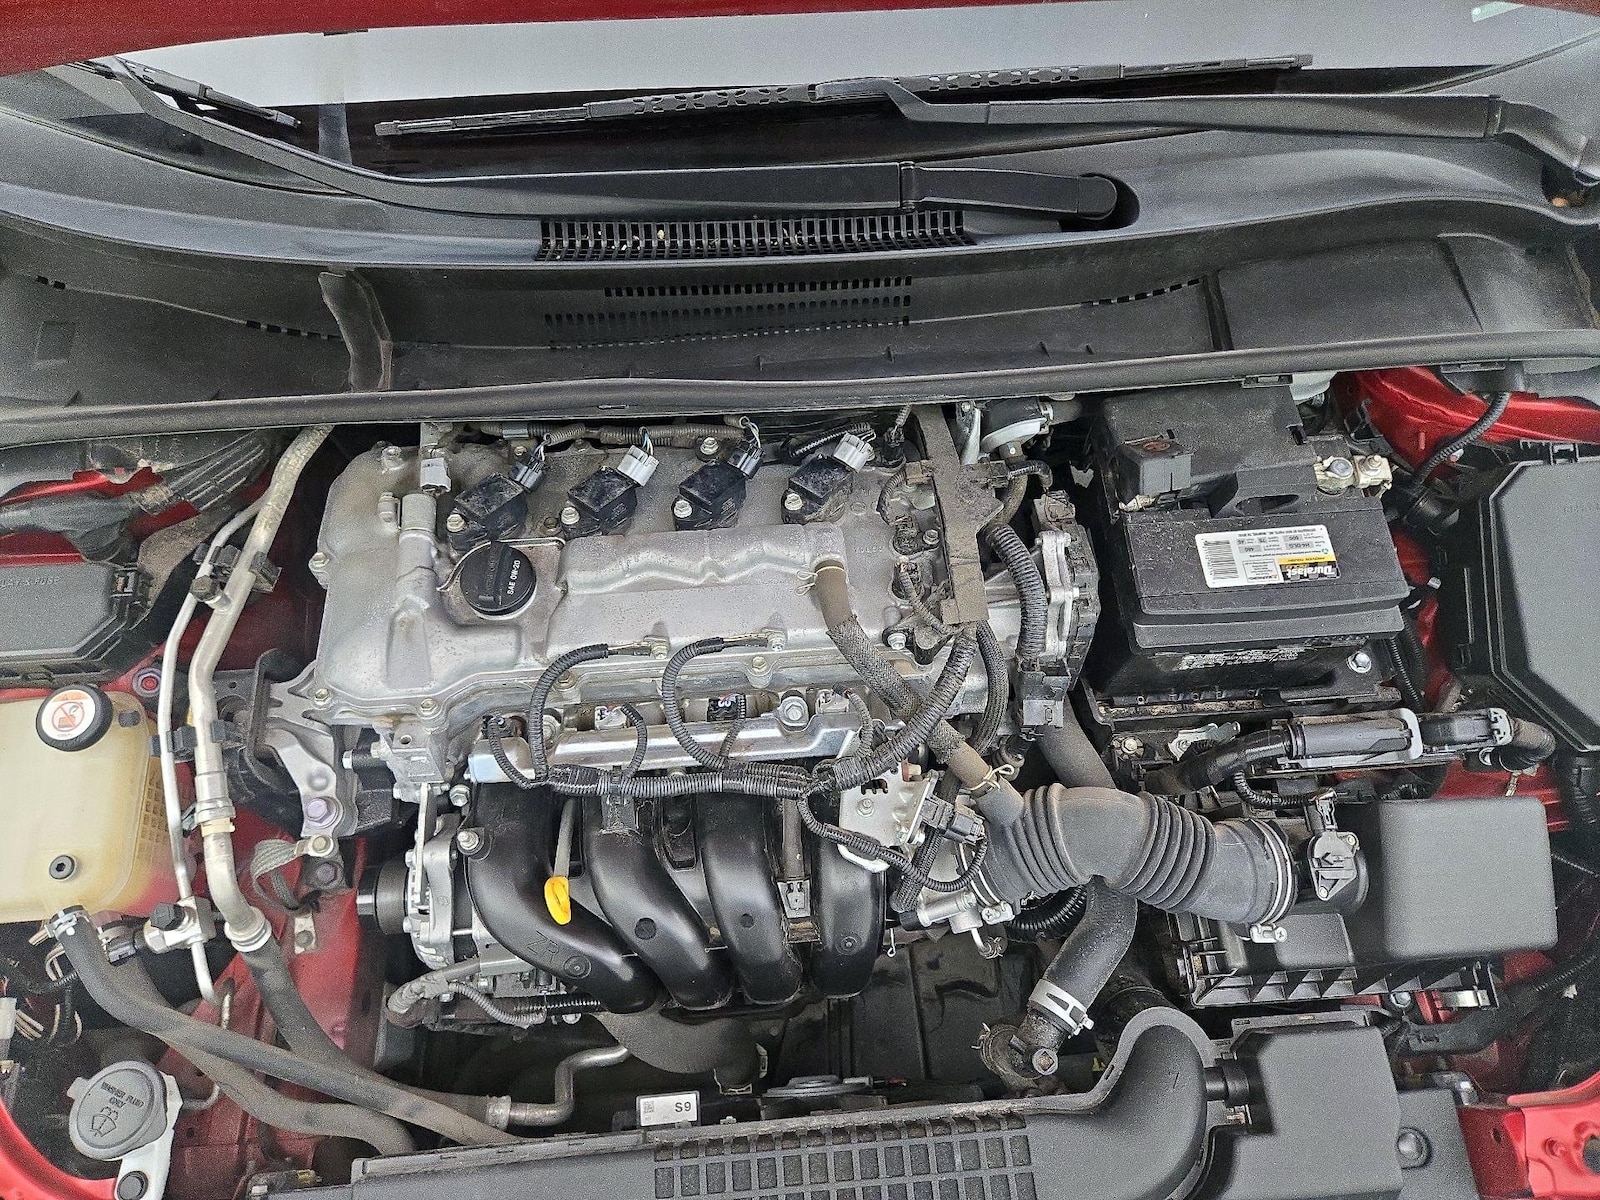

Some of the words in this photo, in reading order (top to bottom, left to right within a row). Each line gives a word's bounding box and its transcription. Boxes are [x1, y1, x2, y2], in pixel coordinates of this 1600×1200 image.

[509, 560, 521, 580] 0W-20
[1286, 565, 1336, 578] Duralast
[507, 581, 516, 595] SAE
[126, 1094, 144, 1108] FLUID
[674, 1101, 692, 1113] S9
